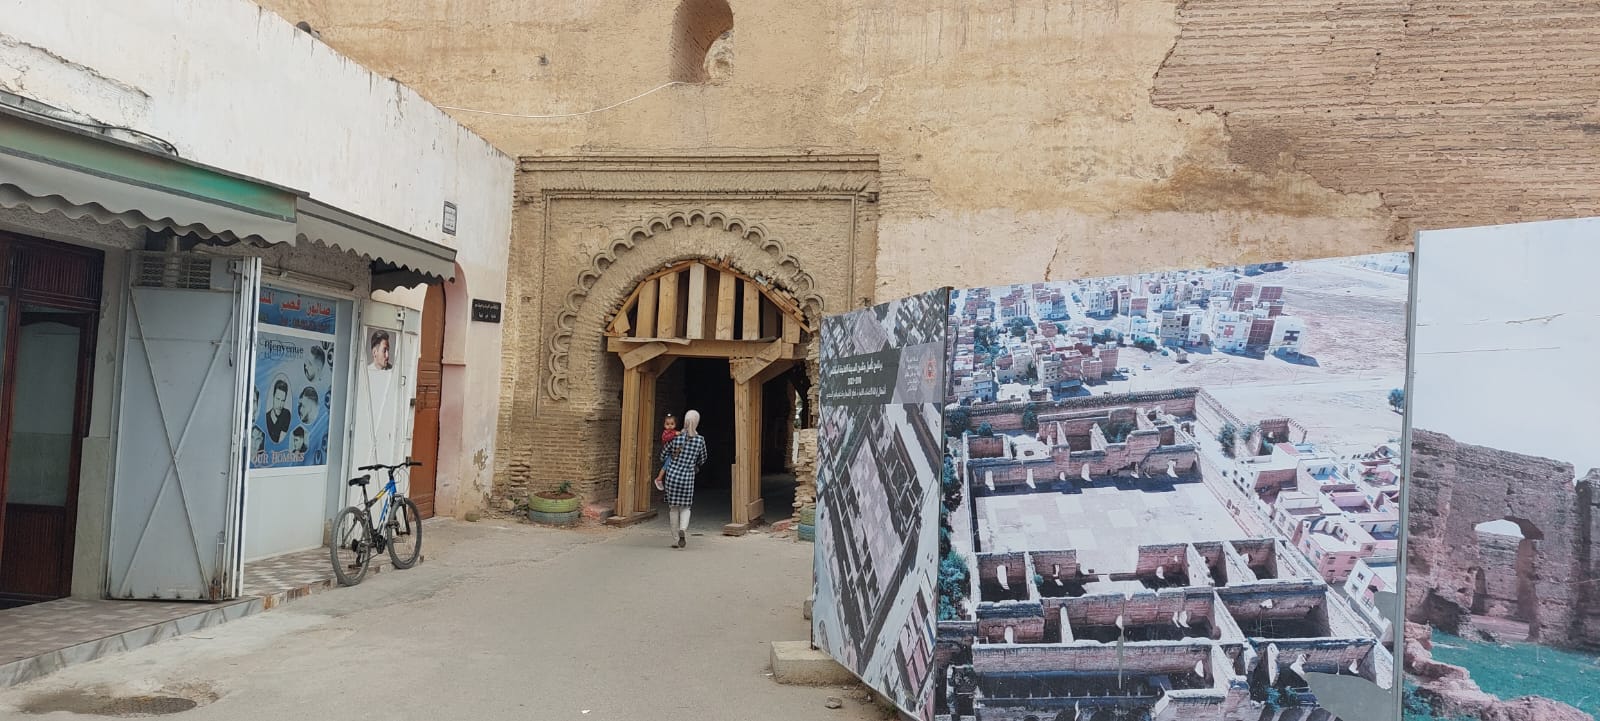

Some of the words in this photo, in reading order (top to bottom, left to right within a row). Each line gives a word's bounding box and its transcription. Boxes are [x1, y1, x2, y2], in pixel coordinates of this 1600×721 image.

[307, 301, 331, 317] صالون
[264, 339, 304, 354] Bienvenue
[253, 450, 269, 465] OUR
